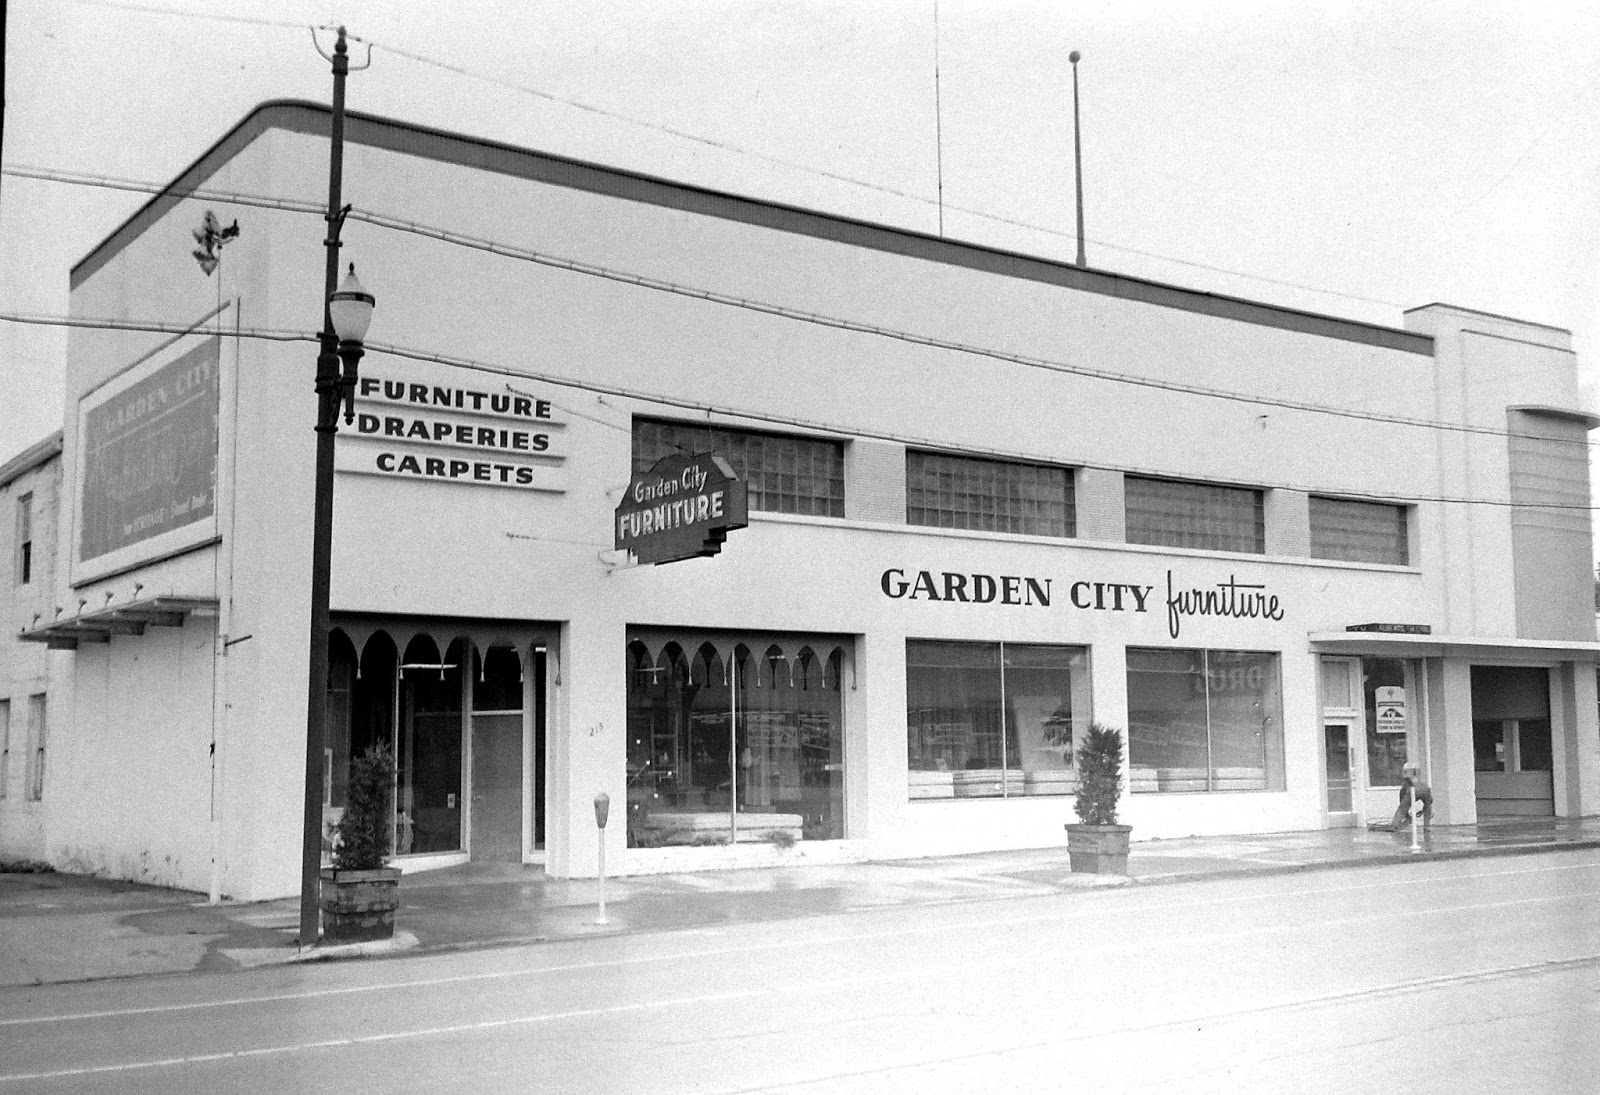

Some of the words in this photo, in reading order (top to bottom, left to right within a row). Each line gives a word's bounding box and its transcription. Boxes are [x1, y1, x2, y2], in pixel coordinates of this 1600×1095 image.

[360, 377, 551, 418] FURNITURE
[358, 413, 550, 451] DRAPERIES
[376, 452, 533, 485] CARPETS
[635, 476, 678, 503] Garden
[682, 465, 707, 492] City
[620, 490, 724, 540] FURNITURE
[880, 568, 1052, 606] GARDEN
[1070, 581, 1154, 612] CITY
[1166, 569, 1284, 639] furniture
